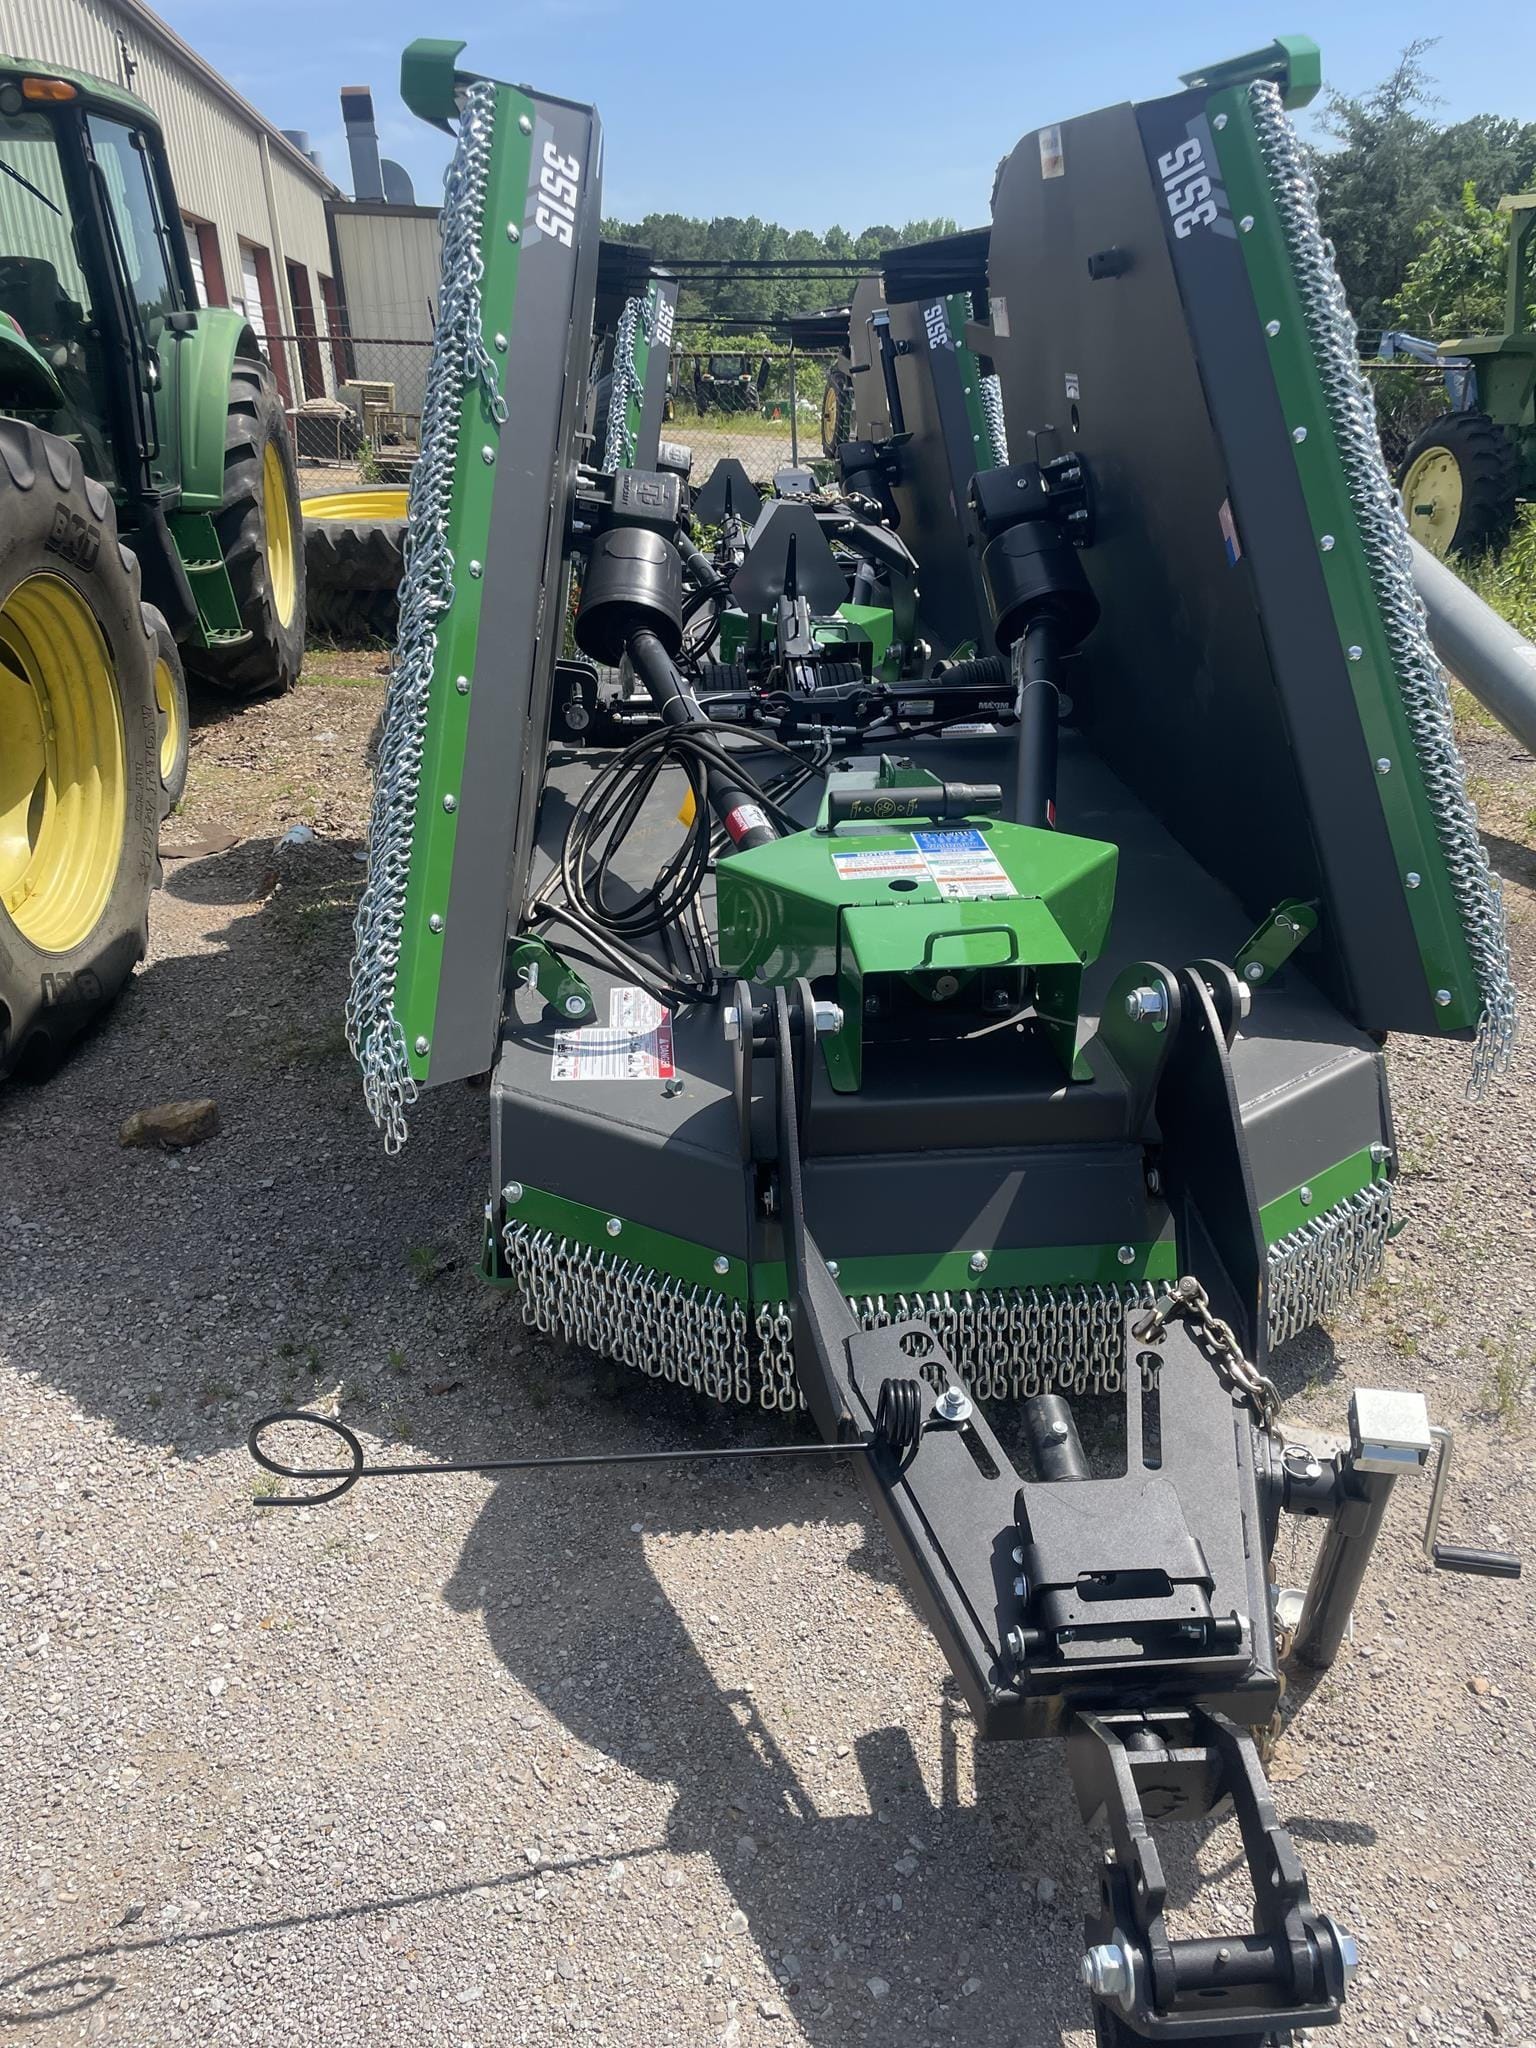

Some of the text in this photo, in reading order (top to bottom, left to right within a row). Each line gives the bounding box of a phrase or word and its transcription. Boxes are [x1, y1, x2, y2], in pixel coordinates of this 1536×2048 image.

[535, 141, 580, 248] 3515
[1157, 138, 1218, 239] 3515
[656, 300, 674, 347] 3515
[924, 304, 948, 350] 3515
[45, 502, 100, 573] BKT
[659, 1044, 671, 1069] DANGER
